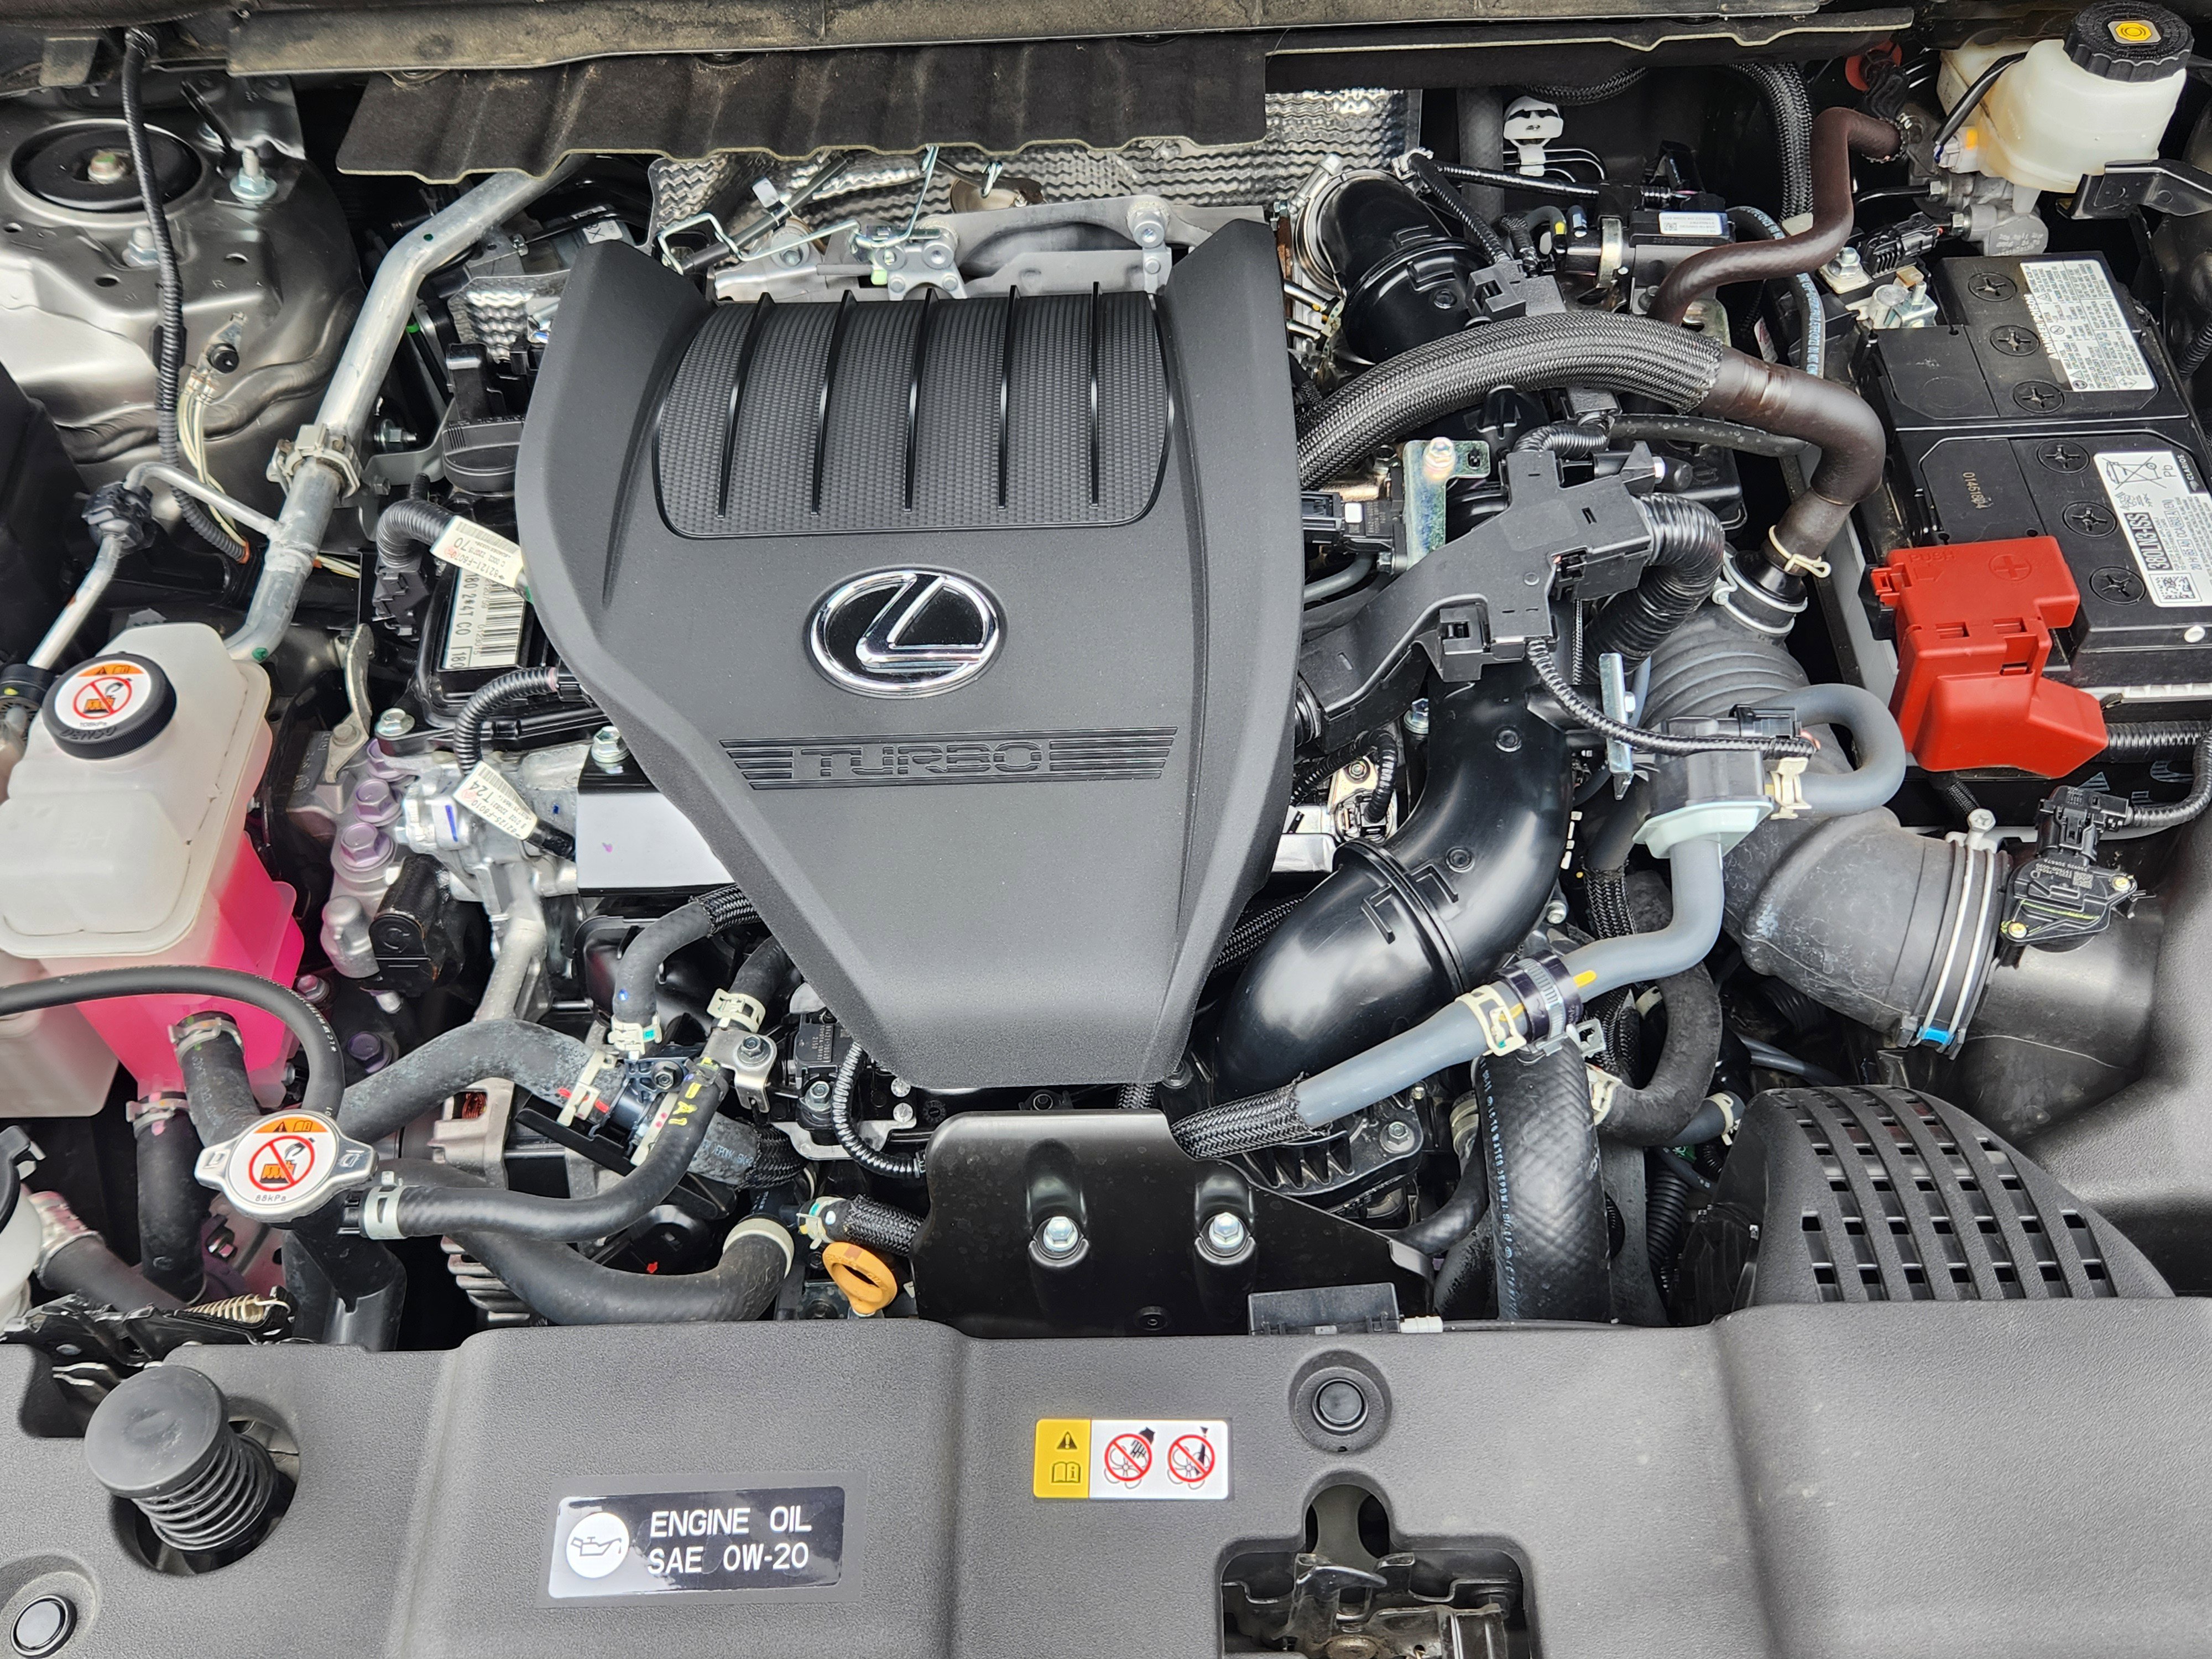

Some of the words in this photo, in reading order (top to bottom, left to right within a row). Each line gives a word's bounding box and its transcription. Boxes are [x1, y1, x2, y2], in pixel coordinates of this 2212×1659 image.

[2024, 294, 2056, 353] DANGER/POISON
[2159, 464, 2177, 477] Pb
[2176, 455, 2195, 480] CLARIOS
[452, 536, 471, 551] 70
[2125, 513, 2171, 568] 380LN3-ISS
[801, 741, 1042, 777] TURBO
[469, 780, 494, 803] T24
[1491, 1133, 1504, 1166] WATER
[650, 1507, 750, 1537] ENGINE
[769, 1505, 812, 1532] OIL
[646, 1546, 702, 1574] SAE
[722, 1542, 809, 1571] 0W-20
